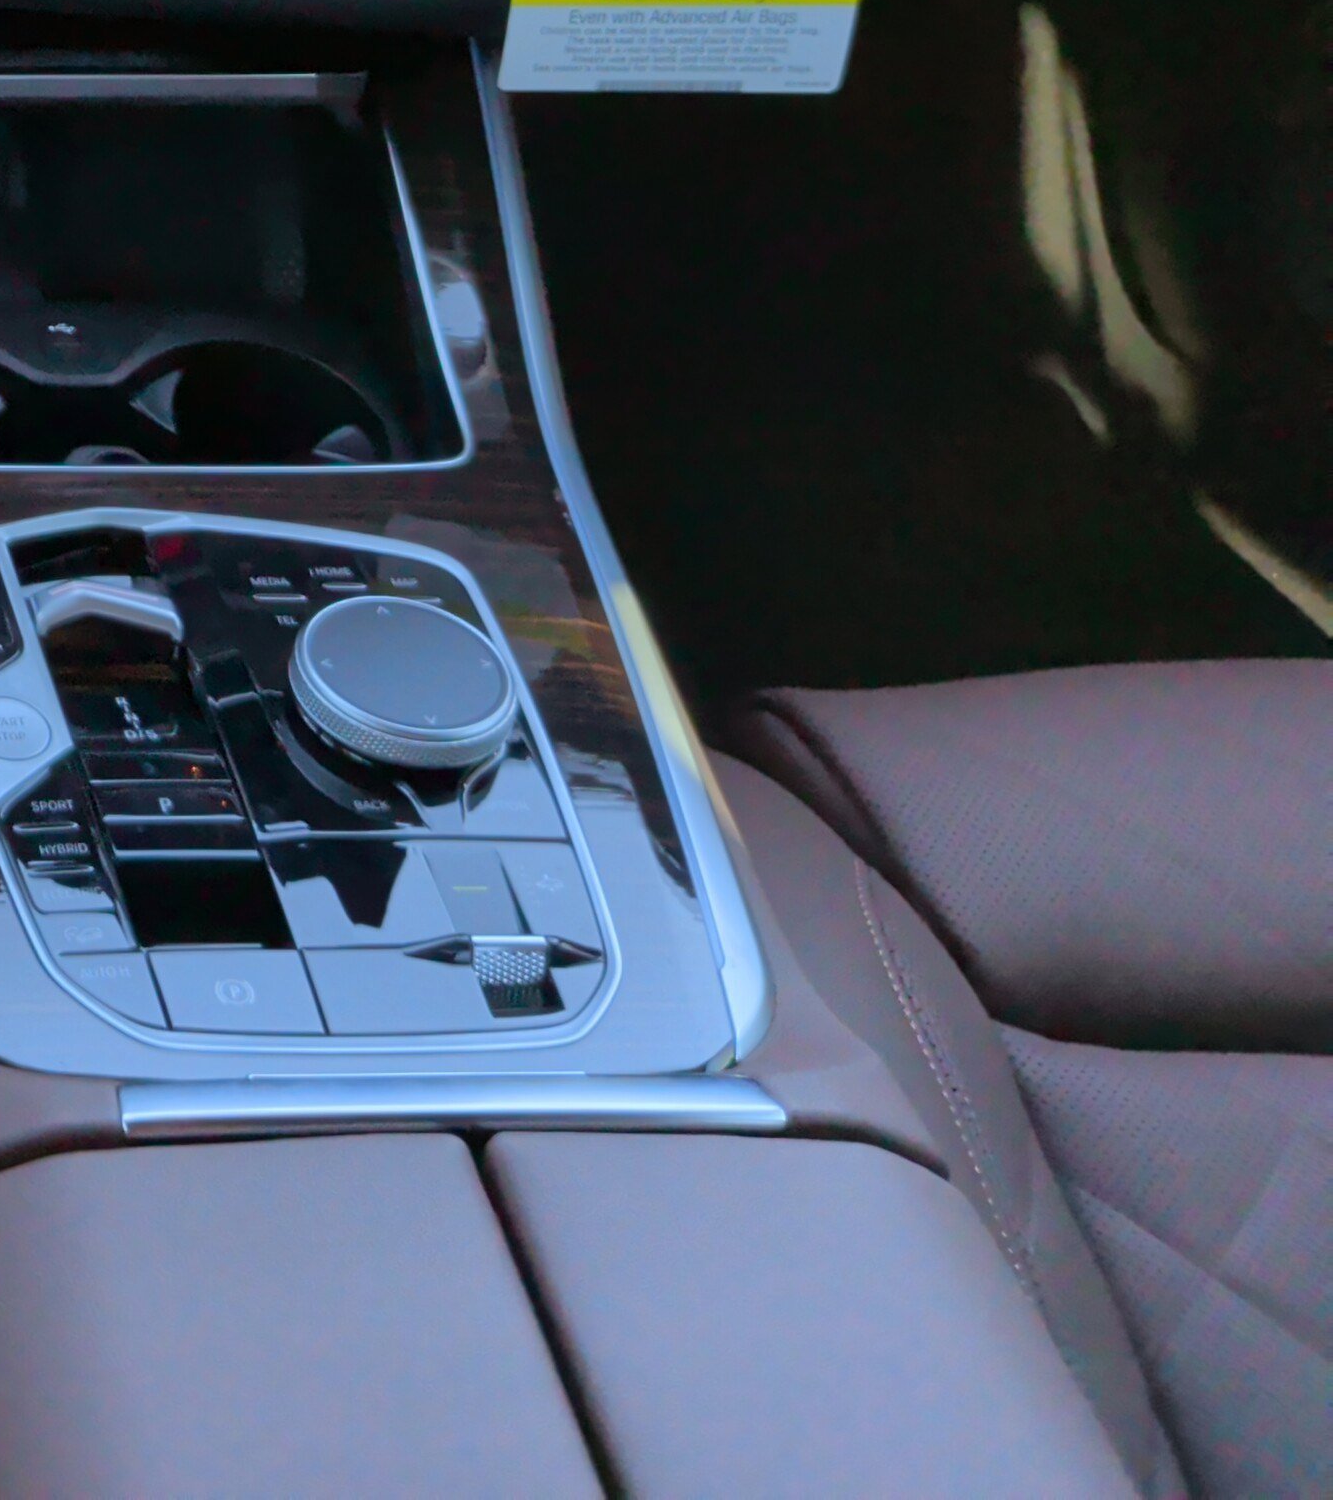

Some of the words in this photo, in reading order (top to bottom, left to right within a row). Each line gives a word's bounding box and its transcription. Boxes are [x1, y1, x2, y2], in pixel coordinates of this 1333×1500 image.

[569, 9, 606, 25] Even
[611, 9, 645, 24] with
[649, 9, 726, 24] Advanced
[731, 9, 755, 24] Air
[759, 9, 798, 26] Bags
[30, 798, 75, 813] SPORT
[157, 796, 175, 814] P
[38, 841, 90, 857] HYBRID
